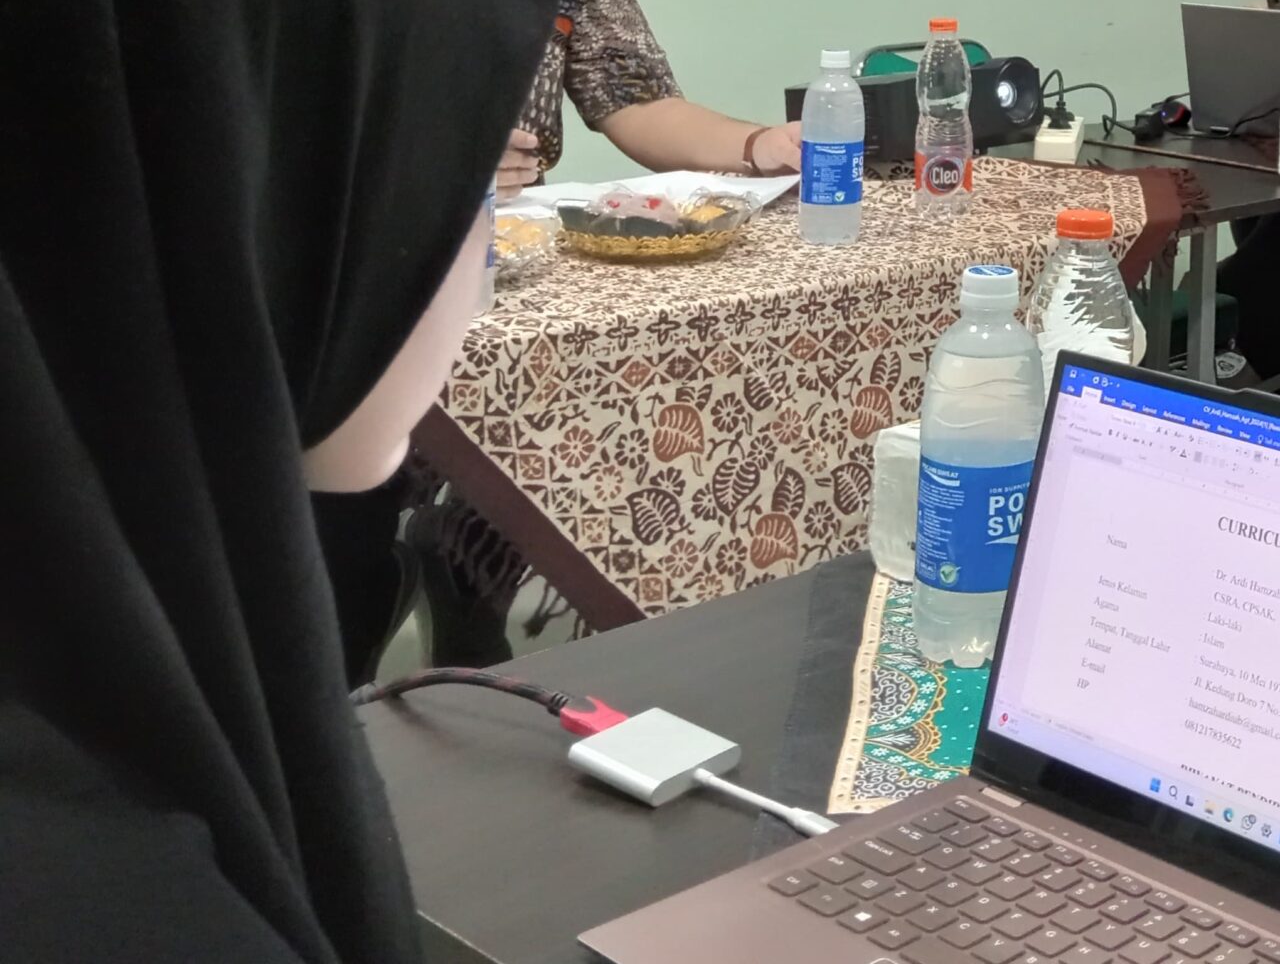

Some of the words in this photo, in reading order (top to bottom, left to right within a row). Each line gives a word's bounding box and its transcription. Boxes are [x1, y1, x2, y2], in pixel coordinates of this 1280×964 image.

[852, 157, 864, 168] PO
[932, 166, 959, 185] Cleo
[988, 492, 1025, 516] PO
[987, 512, 1023, 537] SW
